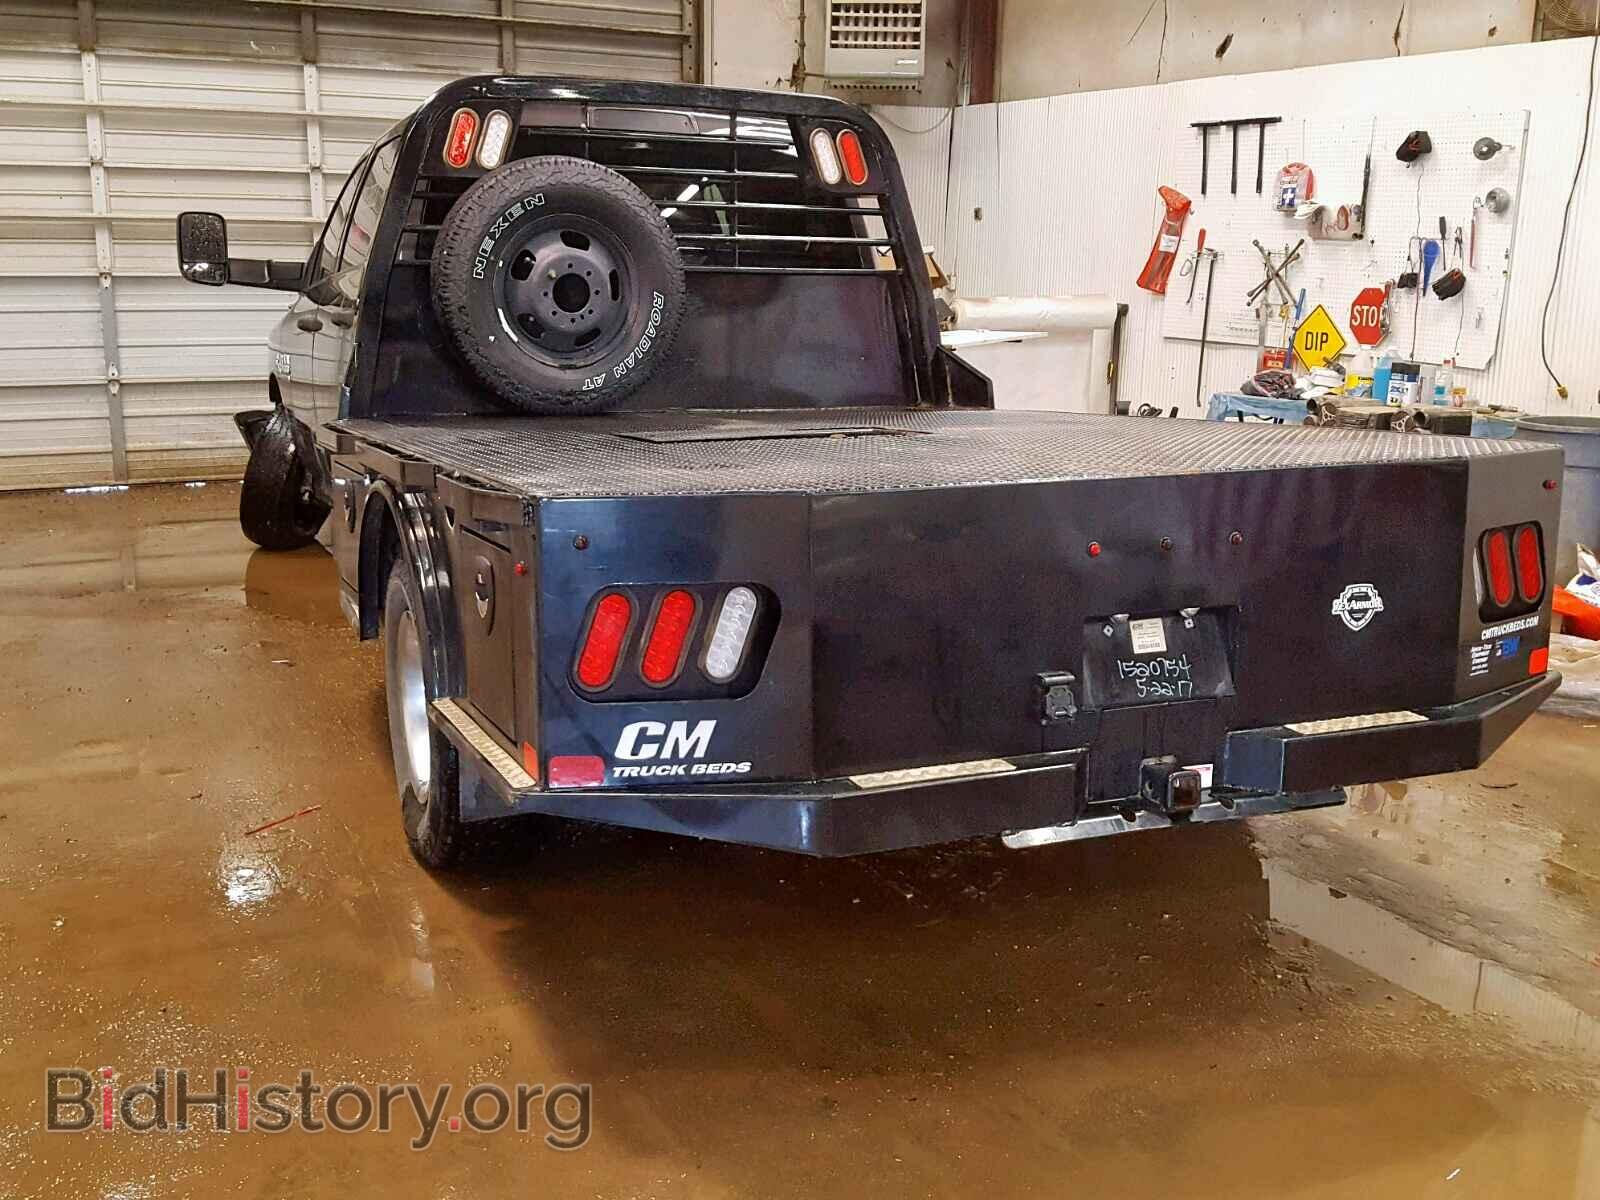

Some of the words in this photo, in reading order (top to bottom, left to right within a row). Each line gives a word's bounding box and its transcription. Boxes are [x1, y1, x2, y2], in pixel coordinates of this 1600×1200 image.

[473, 193, 545, 279] NEXEN
[613, 291, 664, 378] ROADIAN
[1304, 331, 1329, 352] DIP
[582, 373, 606, 391] AT
[613, 719, 717, 760] CM
[612, 763, 688, 778] TRUCK
[690, 761, 752, 776] BEDS
